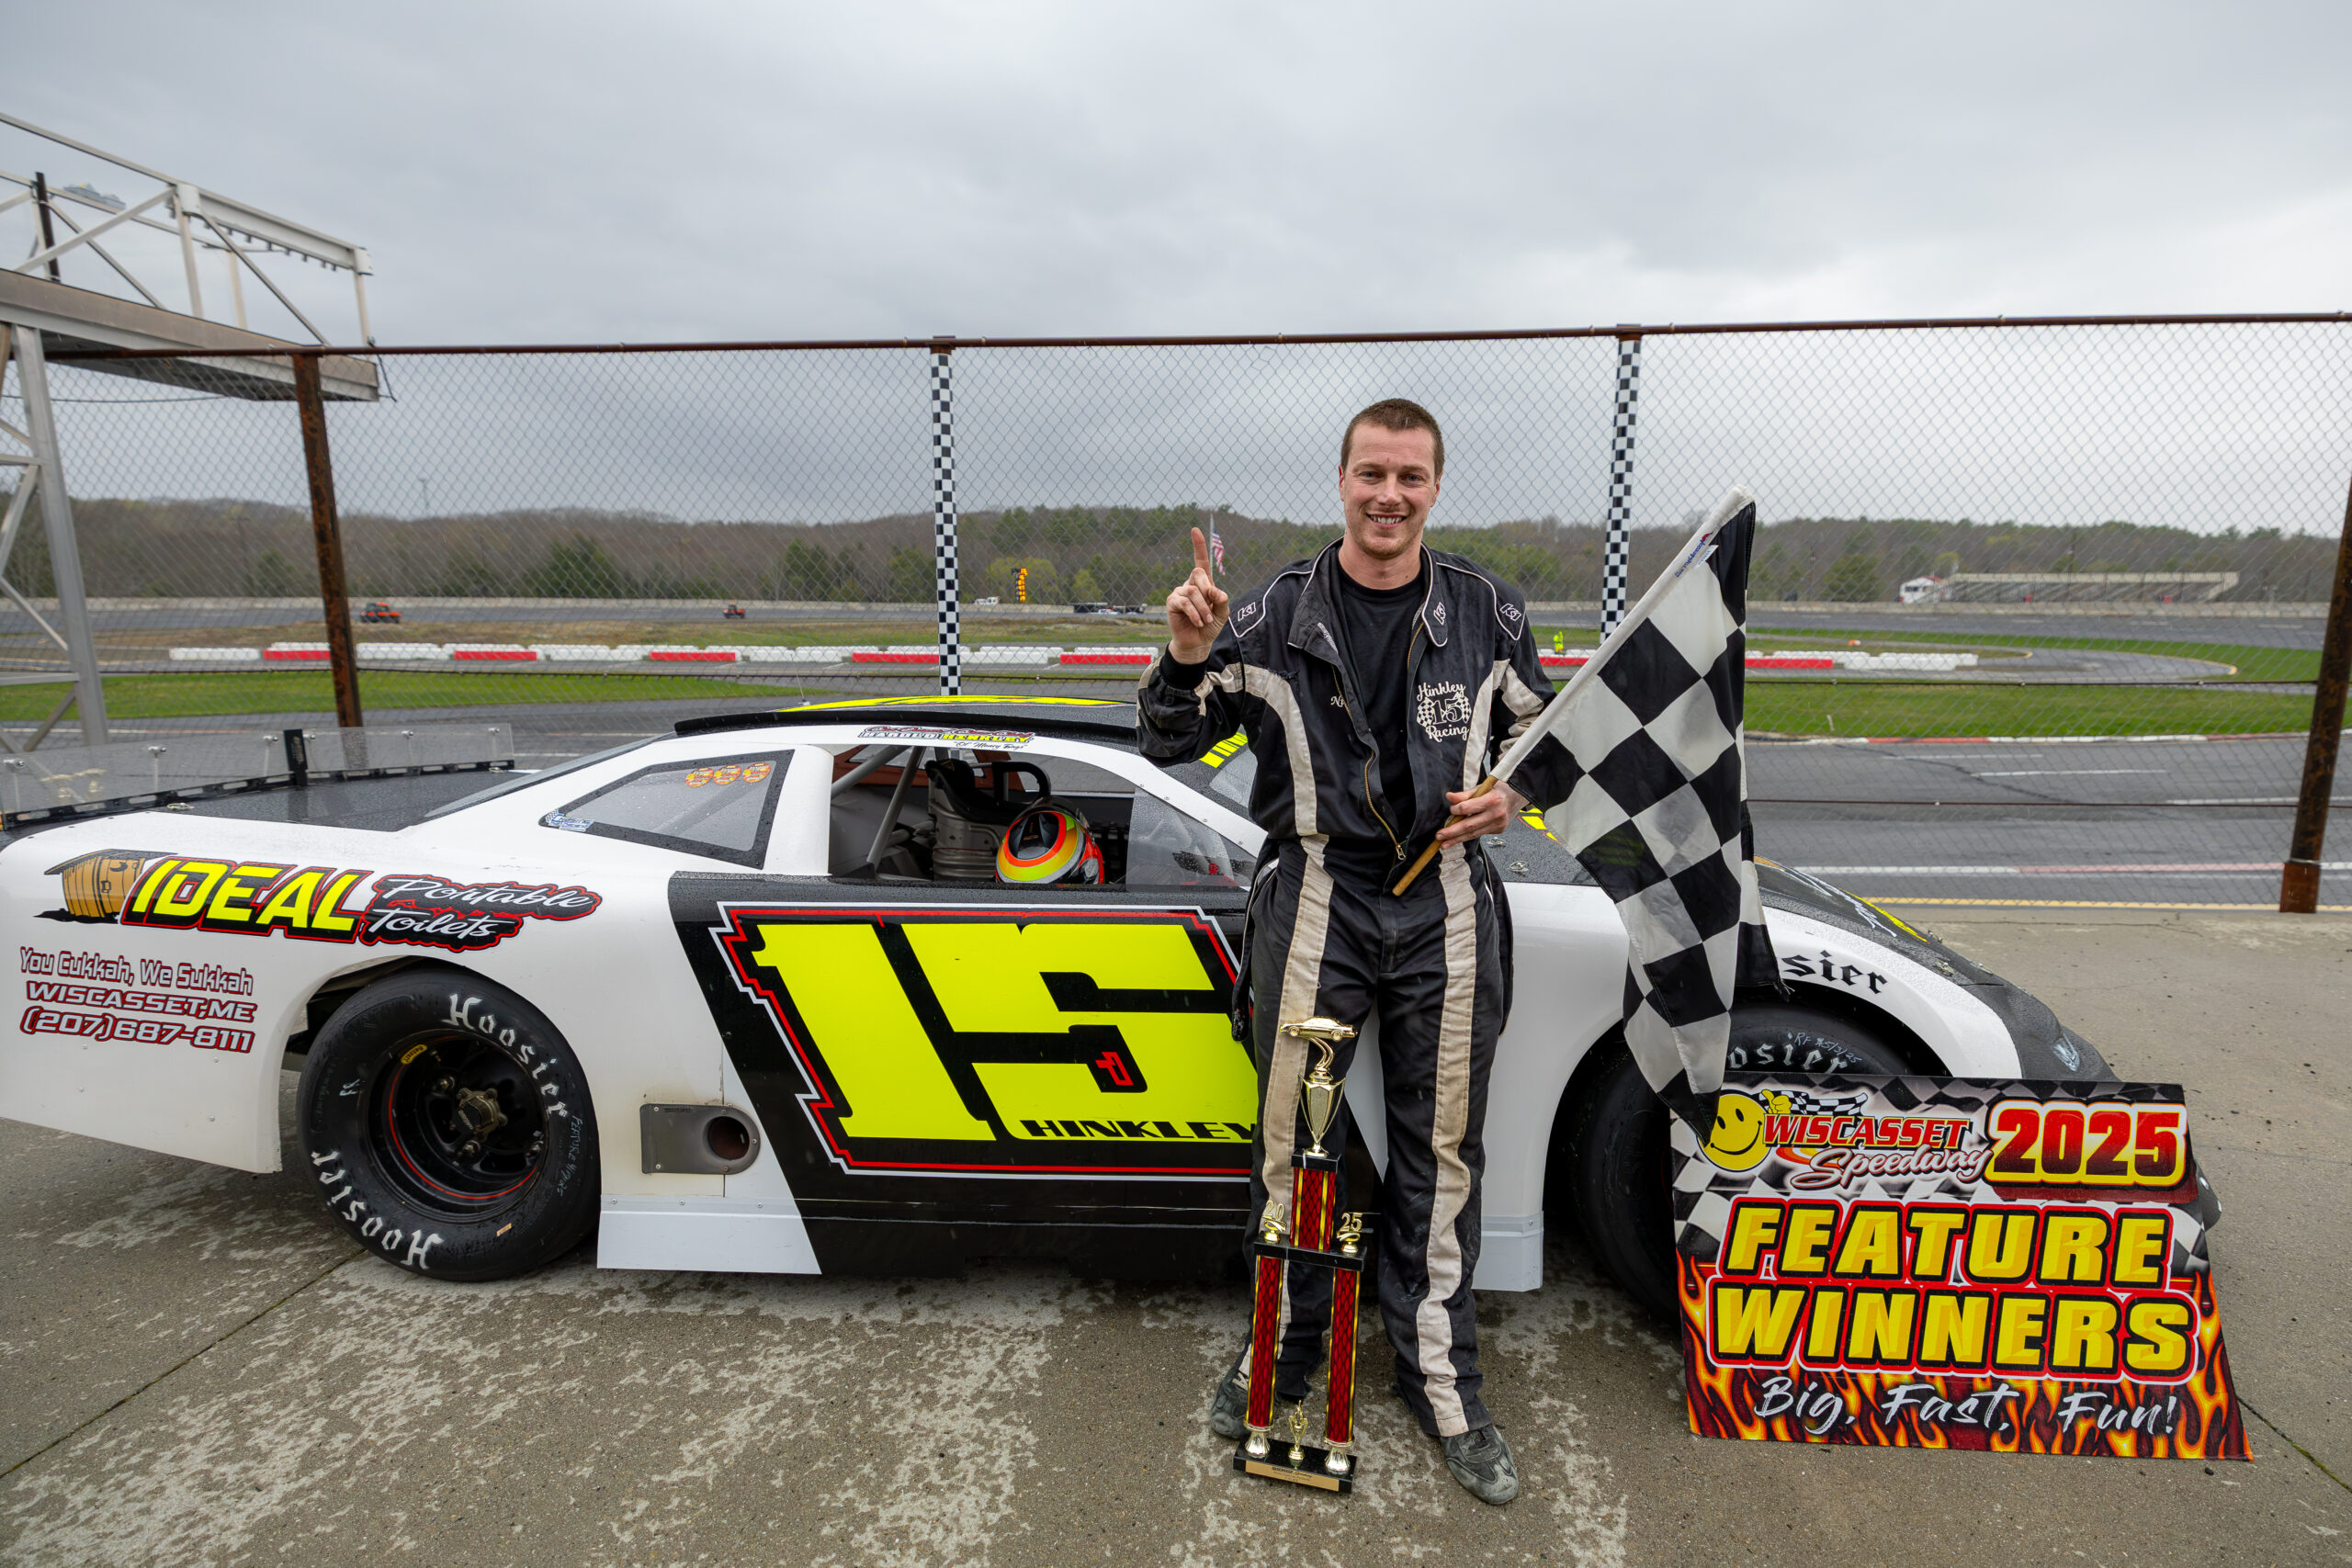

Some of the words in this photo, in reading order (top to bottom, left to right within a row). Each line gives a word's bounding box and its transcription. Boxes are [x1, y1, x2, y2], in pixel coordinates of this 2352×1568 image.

[1417, 681, 1466, 701] Hinkley
[1433, 695, 1463, 725] 15
[1425, 722, 1470, 743] Racing
[127, 858, 369, 936] IDEAL
[388, 878, 594, 908] Portable
[368, 907, 516, 940] Toilets
[20, 946, 54, 976] You
[57, 951, 135, 987] Cukkah,
[140, 958, 173, 987] We
[175, 962, 254, 997] Sukkah
[20, 1006, 255, 1054] (207)687-8111
[441, 989, 568, 1118] Hoosier
[751, 922, 1258, 1143] 15
[1763, 1114, 1970, 1148] WISCASSET
[1992, 1108, 2185, 1178] 2025
[1791, 1146, 1992, 1190] Speedway
[311, 1150, 445, 1270] Hoosier
[1262, 1200, 1285, 1222] 20
[1340, 1213, 1363, 1232] 25
[1723, 1203, 2169, 1287] FEATURE
[1714, 1286, 2194, 1371] WINNERS
[1754, 1377, 1855, 1434] Big,
[1881, 1383, 2021, 1430] Fast,
[2058, 1393, 2177, 1435] Fun!
